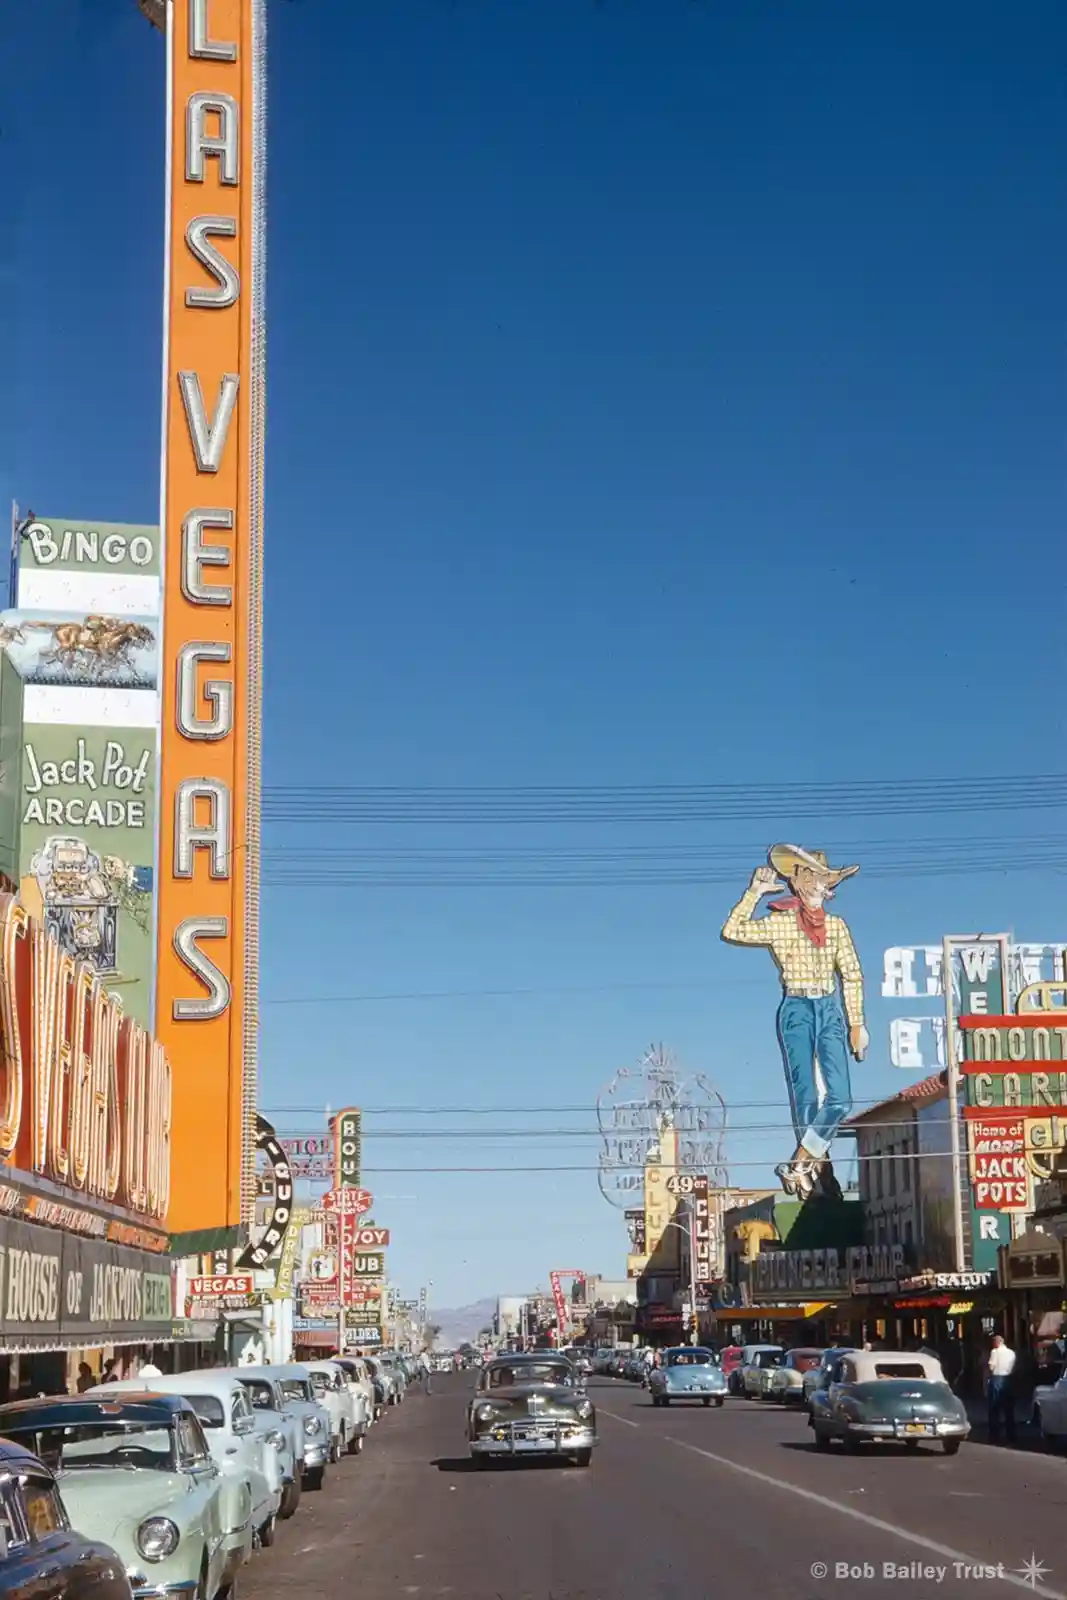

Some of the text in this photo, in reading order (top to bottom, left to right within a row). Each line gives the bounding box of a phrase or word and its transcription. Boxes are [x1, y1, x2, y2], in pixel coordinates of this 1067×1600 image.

[171, 0, 241, 1021] LAS VEGAS
[27, 522, 154, 566] BINGO
[25, 739, 151, 794] Jack Pot
[23, 799, 145, 828] ARCADE
[974, 1122, 1024, 1137] Home of
[342, 1121, 356, 1175] BOU
[976, 1157, 1026, 1178] JACK
[976, 1181, 1026, 1203] POTS
[6, 1248, 59, 1321] HOUSE
[67, 1270, 83, 1314] OF
[89, 1263, 143, 1322] JACKPOTS
[193, 1278, 247, 1292] VEGAS
